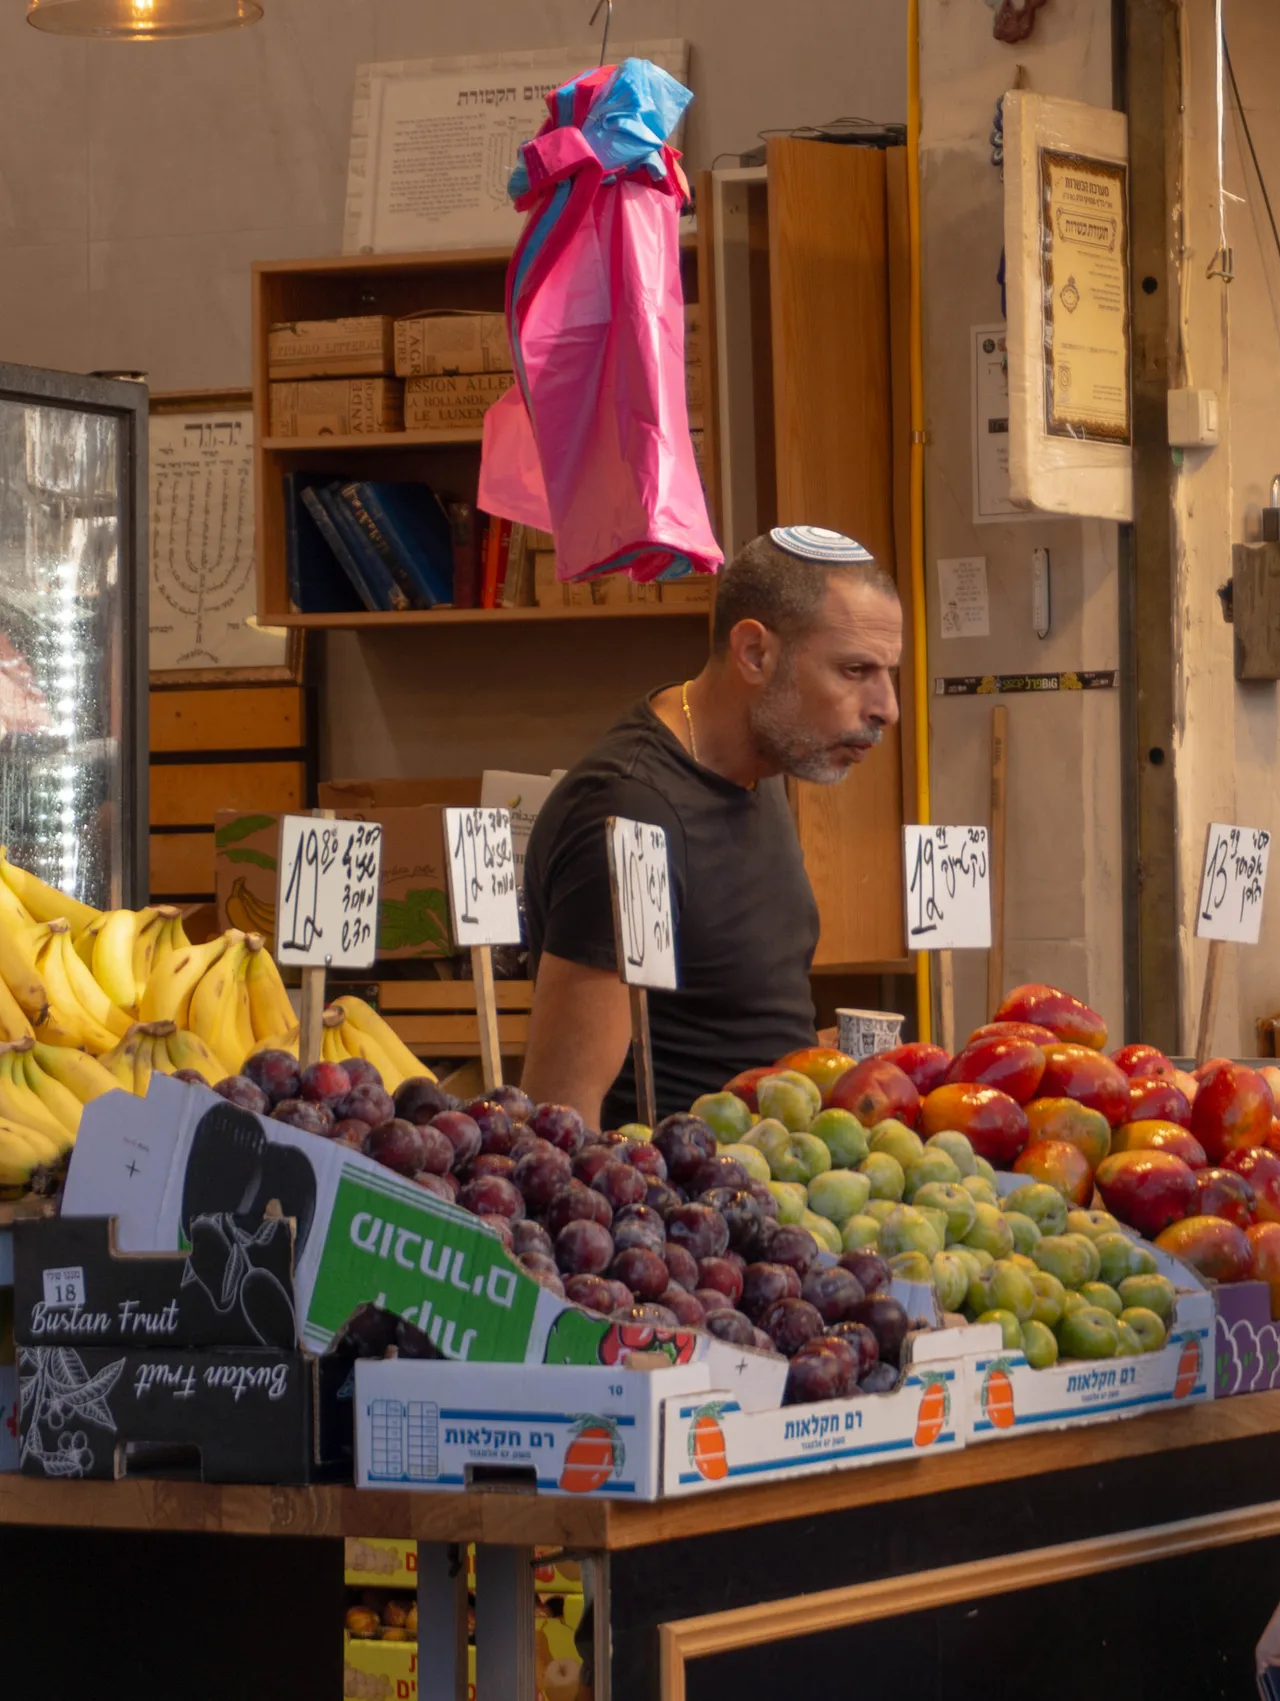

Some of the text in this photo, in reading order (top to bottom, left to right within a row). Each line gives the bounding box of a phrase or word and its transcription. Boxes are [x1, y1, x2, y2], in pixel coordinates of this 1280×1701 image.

[457, 87, 517, 107] הקטורת
[351, 1212, 518, 1309] מובחרים
[55, 1284, 77, 1303] 18
[30, 1298, 180, 1335] Bustan Fruit
[134, 1363, 289, 1402] Bustan Fruit
[608, 1385, 624, 1396] 10
[1066, 1369, 1117, 1393] חקלאות
[784, 1410, 863, 1440] רם חקלאות
[444, 1426, 555, 1450] רם חקלאות
